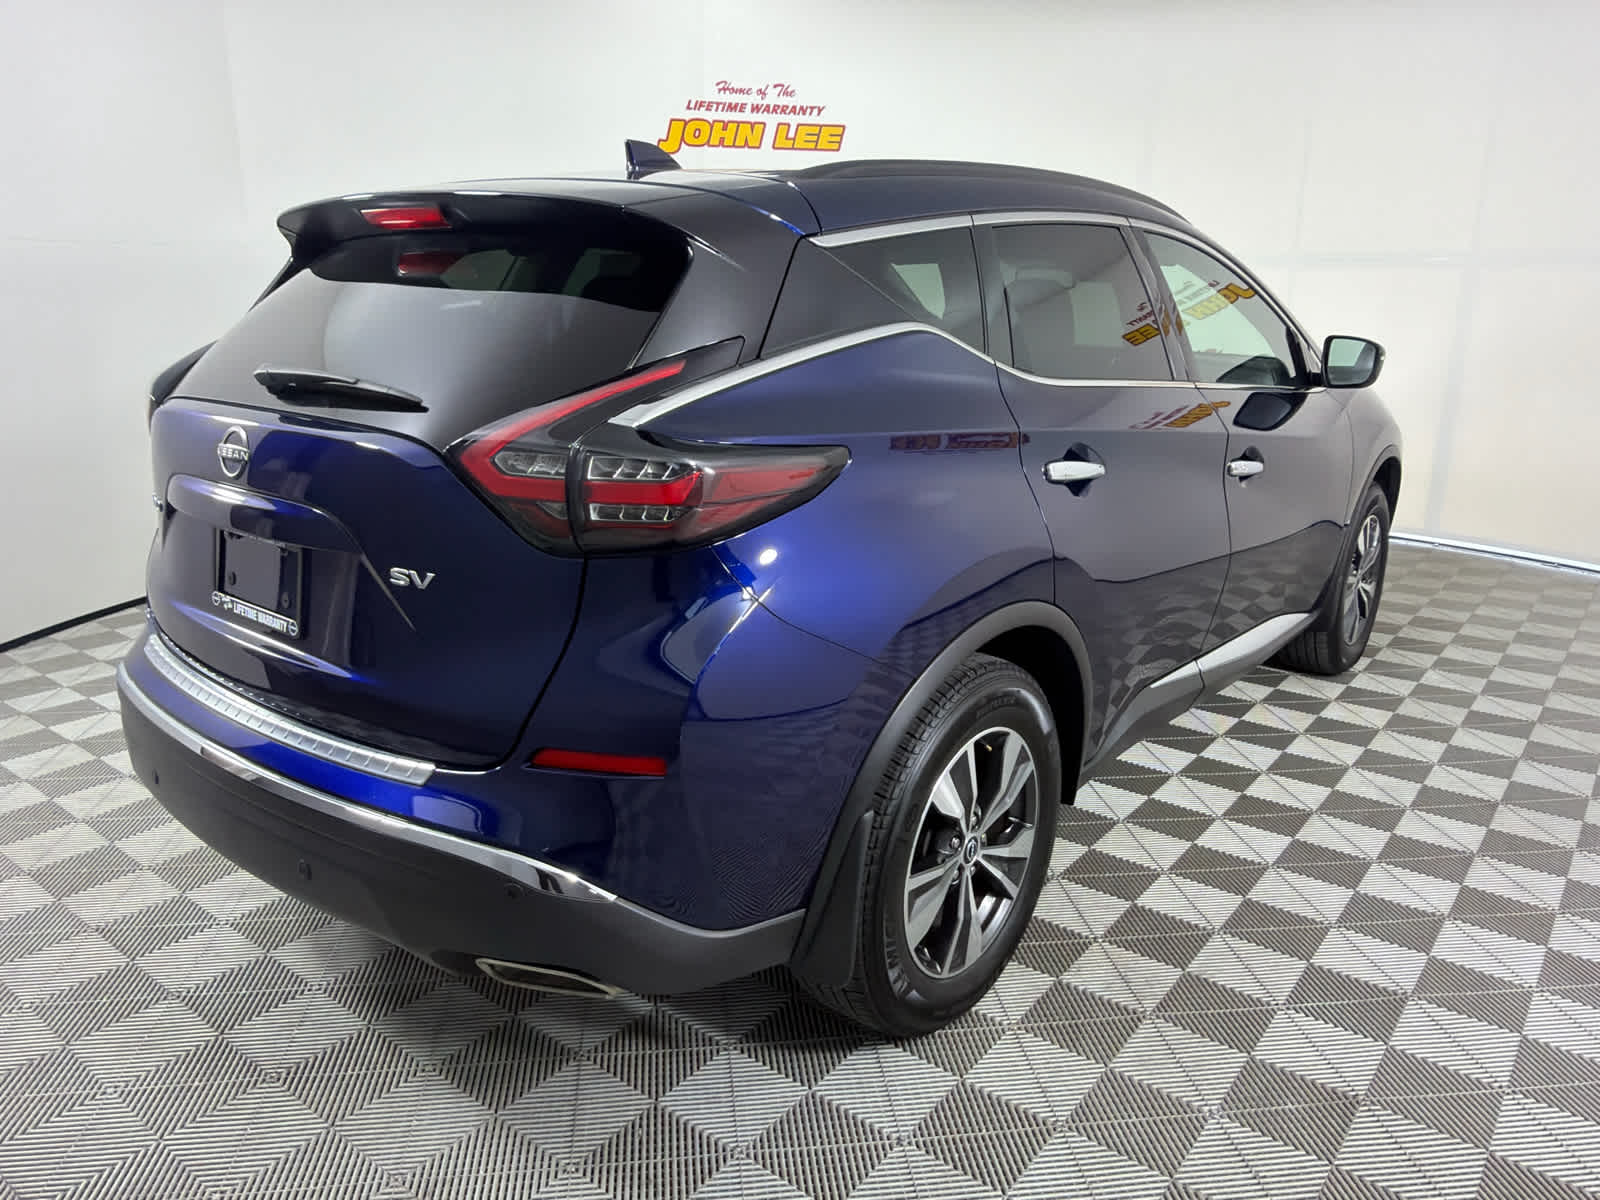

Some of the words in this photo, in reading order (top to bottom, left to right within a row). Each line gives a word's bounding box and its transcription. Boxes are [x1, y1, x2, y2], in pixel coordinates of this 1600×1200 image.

[715, 80, 753, 96] Home
[756, 84, 770, 100] of
[772, 83, 796, 98] The
[686, 99, 748, 113] LIFETIME
[750, 102, 825, 116] WARRANTY
[657, 118, 766, 154] JOHN
[772, 122, 846, 152] LEE
[389, 567, 436, 590] SV
